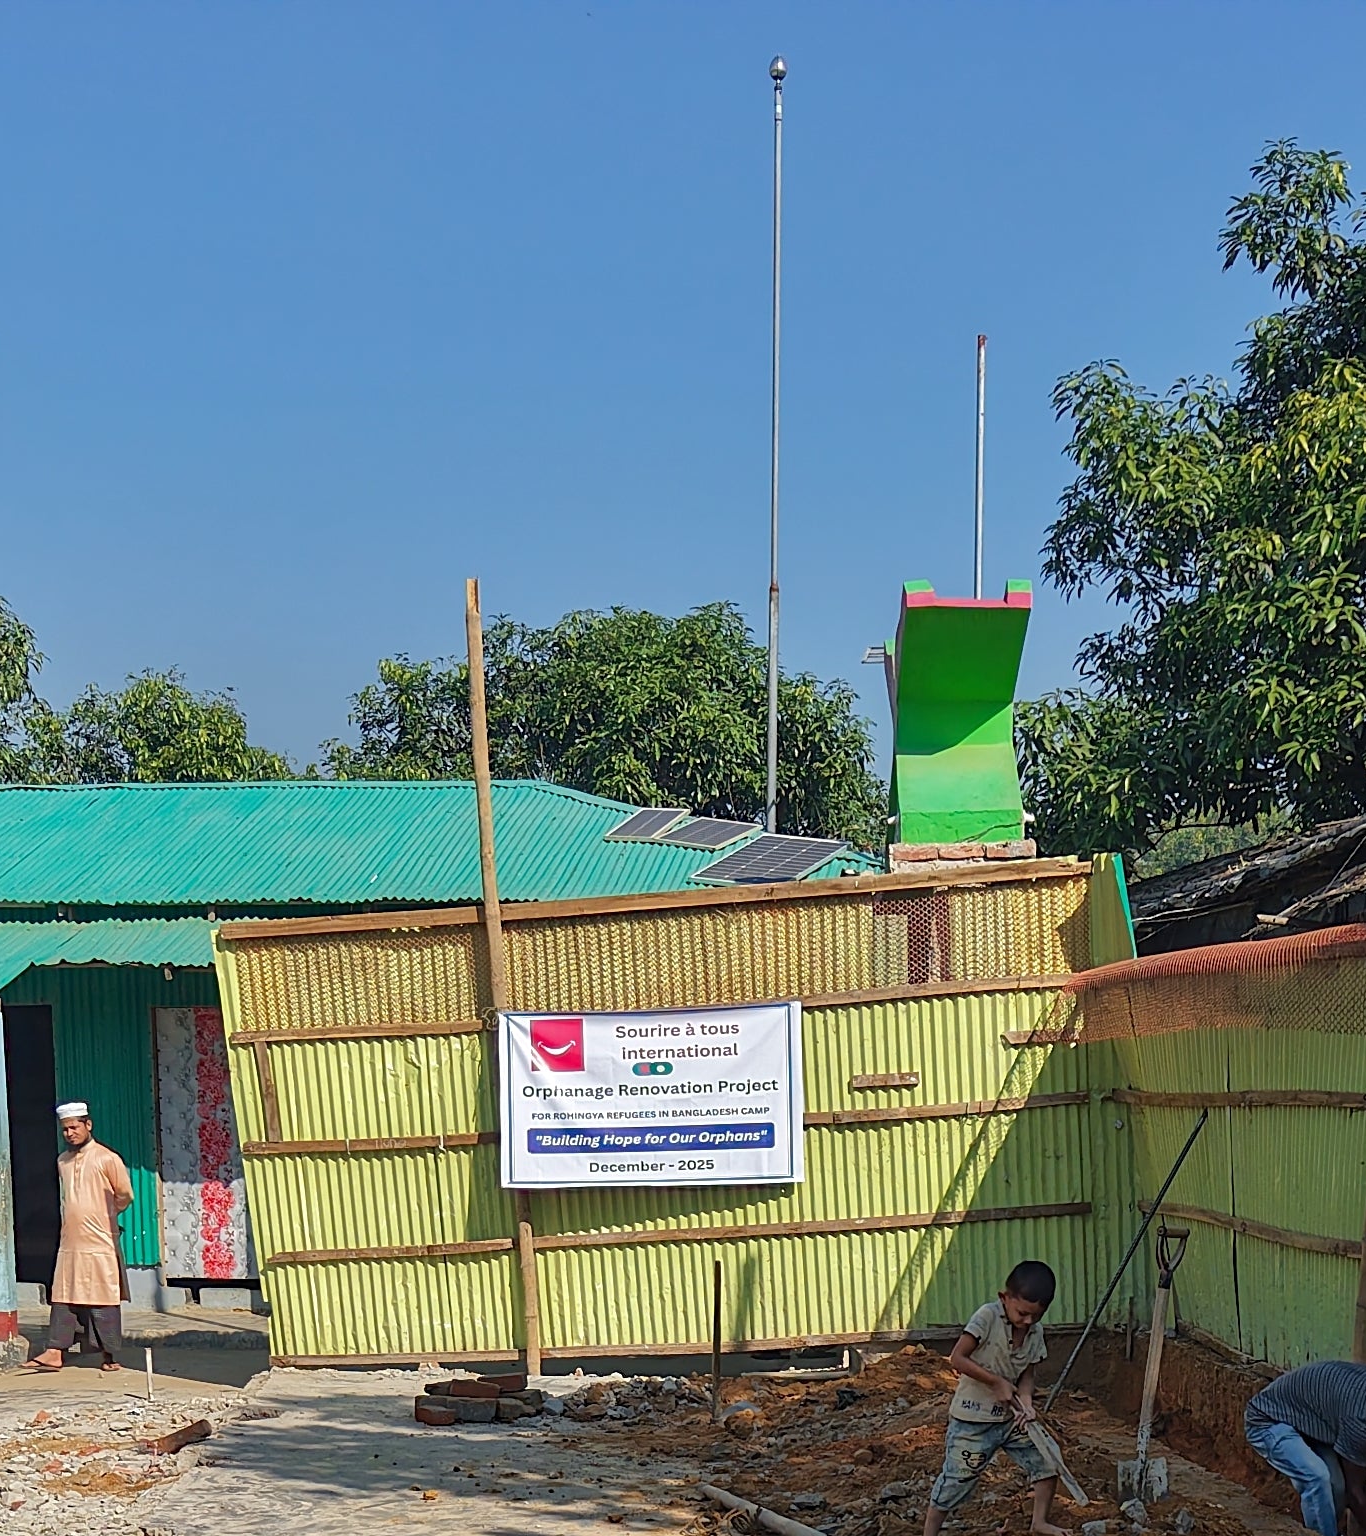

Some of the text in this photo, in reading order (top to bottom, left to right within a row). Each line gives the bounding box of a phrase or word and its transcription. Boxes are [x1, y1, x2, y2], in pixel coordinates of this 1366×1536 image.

[616, 1023, 739, 1038] Sourire à tous
[622, 1043, 738, 1060] international
[523, 1079, 778, 1100] Orphanage Renovation Project
[532, 1107, 770, 1120] FOR ROHINGYA REFUGEES IN BANGLADESH CAMP
[603, 1134, 641, 1147] Hope
[645, 1133, 666, 1144] for
[669, 1132, 696, 1144] Our
[590, 1161, 665, 1173] December
[678, 1160, 714, 1171] 2025
